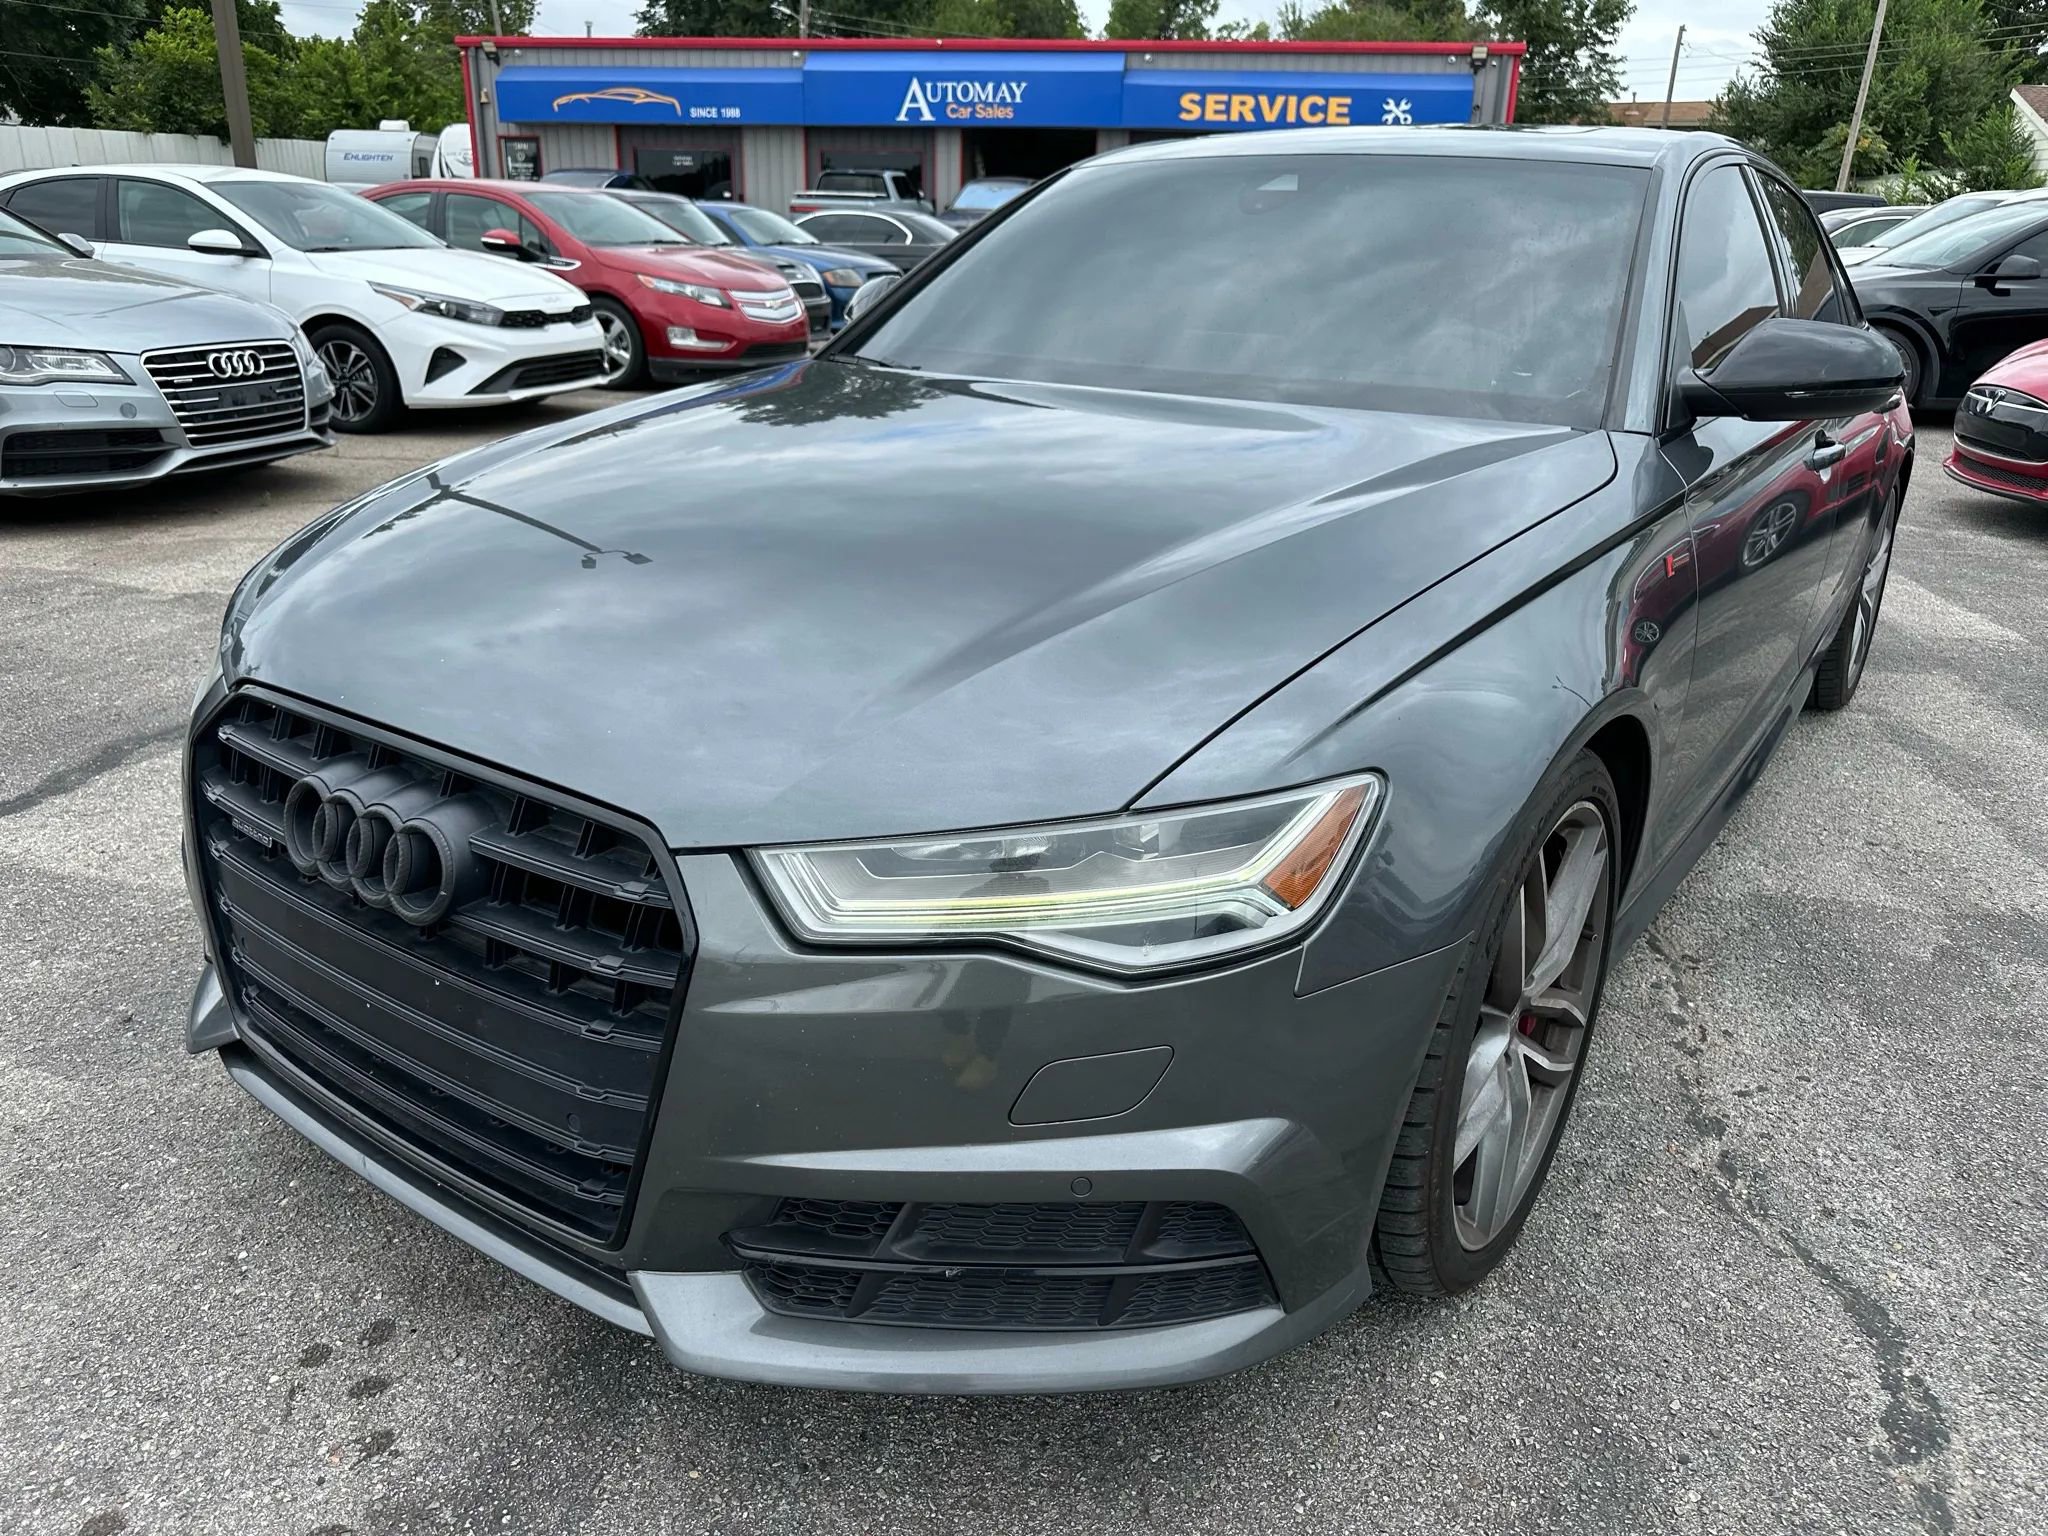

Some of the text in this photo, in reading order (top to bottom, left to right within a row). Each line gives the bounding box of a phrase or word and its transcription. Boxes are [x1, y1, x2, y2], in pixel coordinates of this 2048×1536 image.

[895, 76, 1028, 121] AUTOMAY
[946, 104, 1014, 119] Car Sales
[1179, 92, 1352, 125] SERVICE
[689, 107, 741, 119] SINCE 1988
[232, 818, 269, 844] quattro
